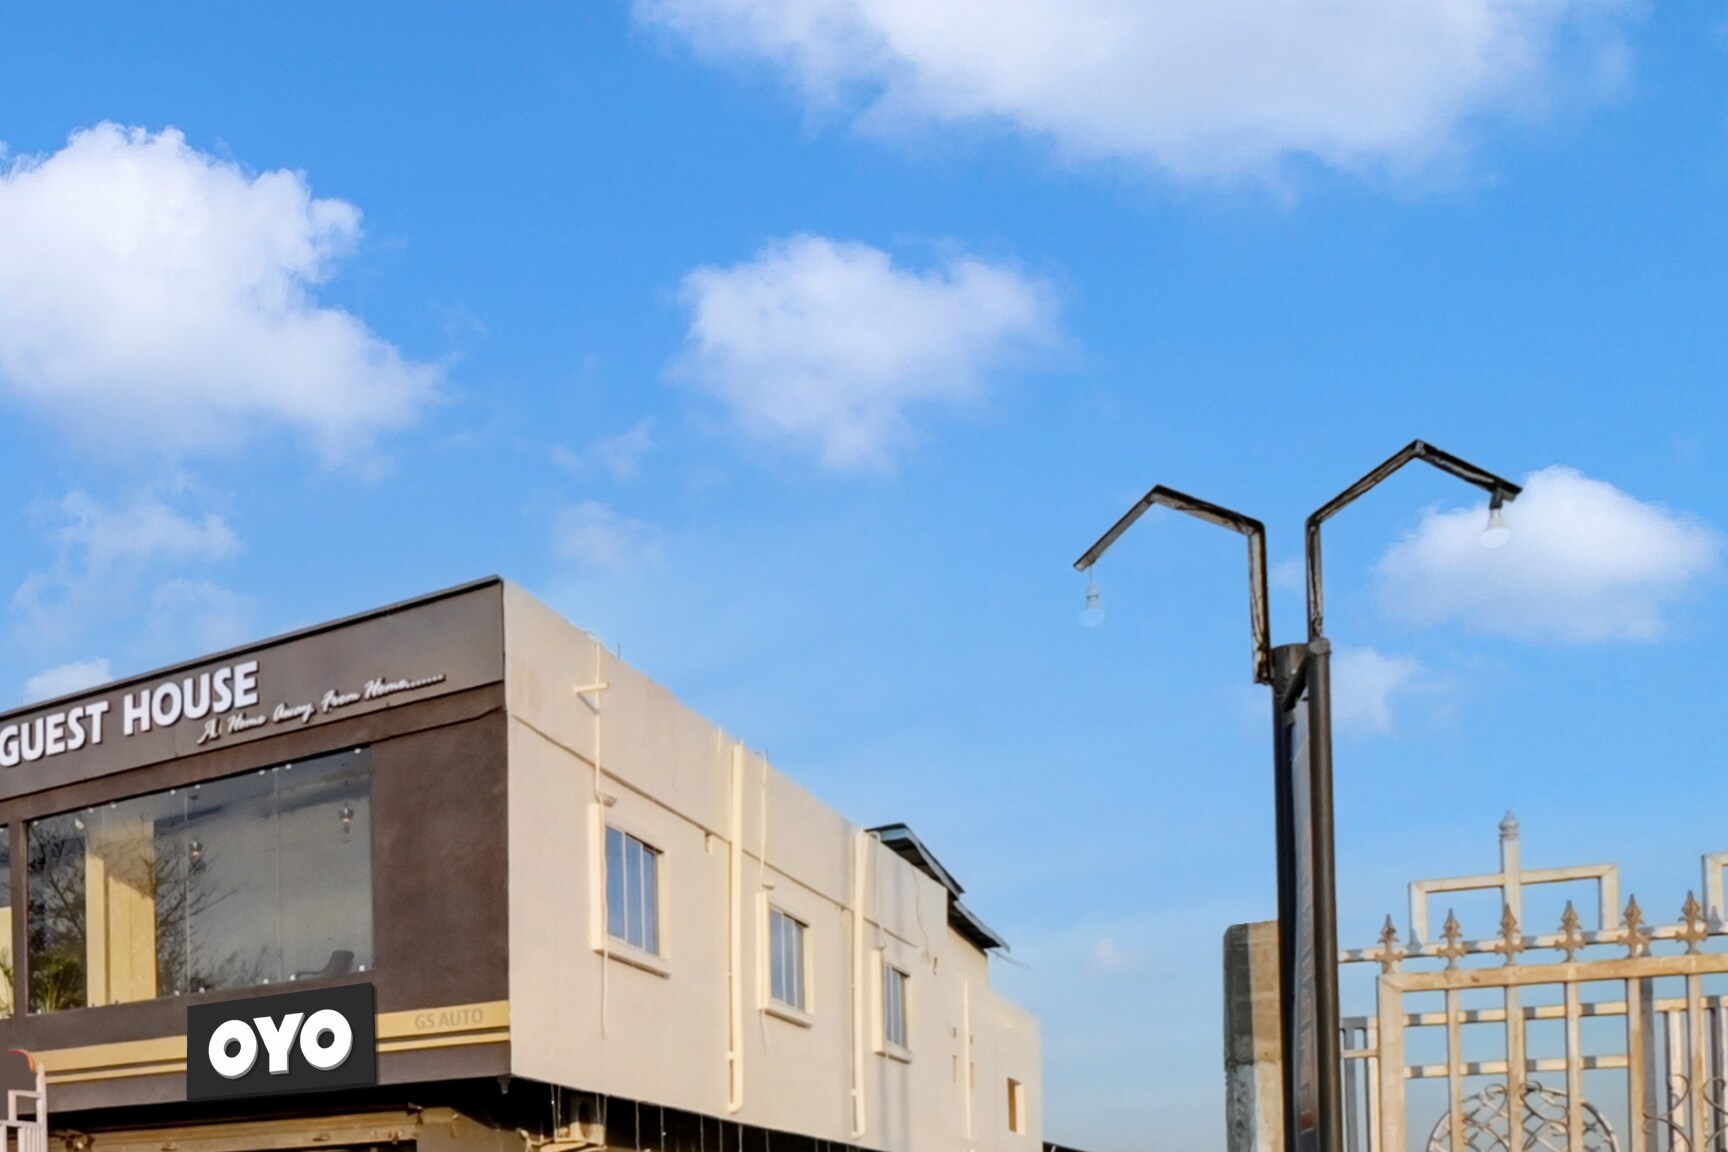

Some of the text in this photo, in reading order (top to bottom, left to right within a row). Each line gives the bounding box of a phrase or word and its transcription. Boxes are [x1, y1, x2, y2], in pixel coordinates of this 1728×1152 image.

[123, 660, 259, 736] HOUSE
[208, 1008, 353, 1080] OYO
[414, 1008, 483, 1030] GS AUTO
